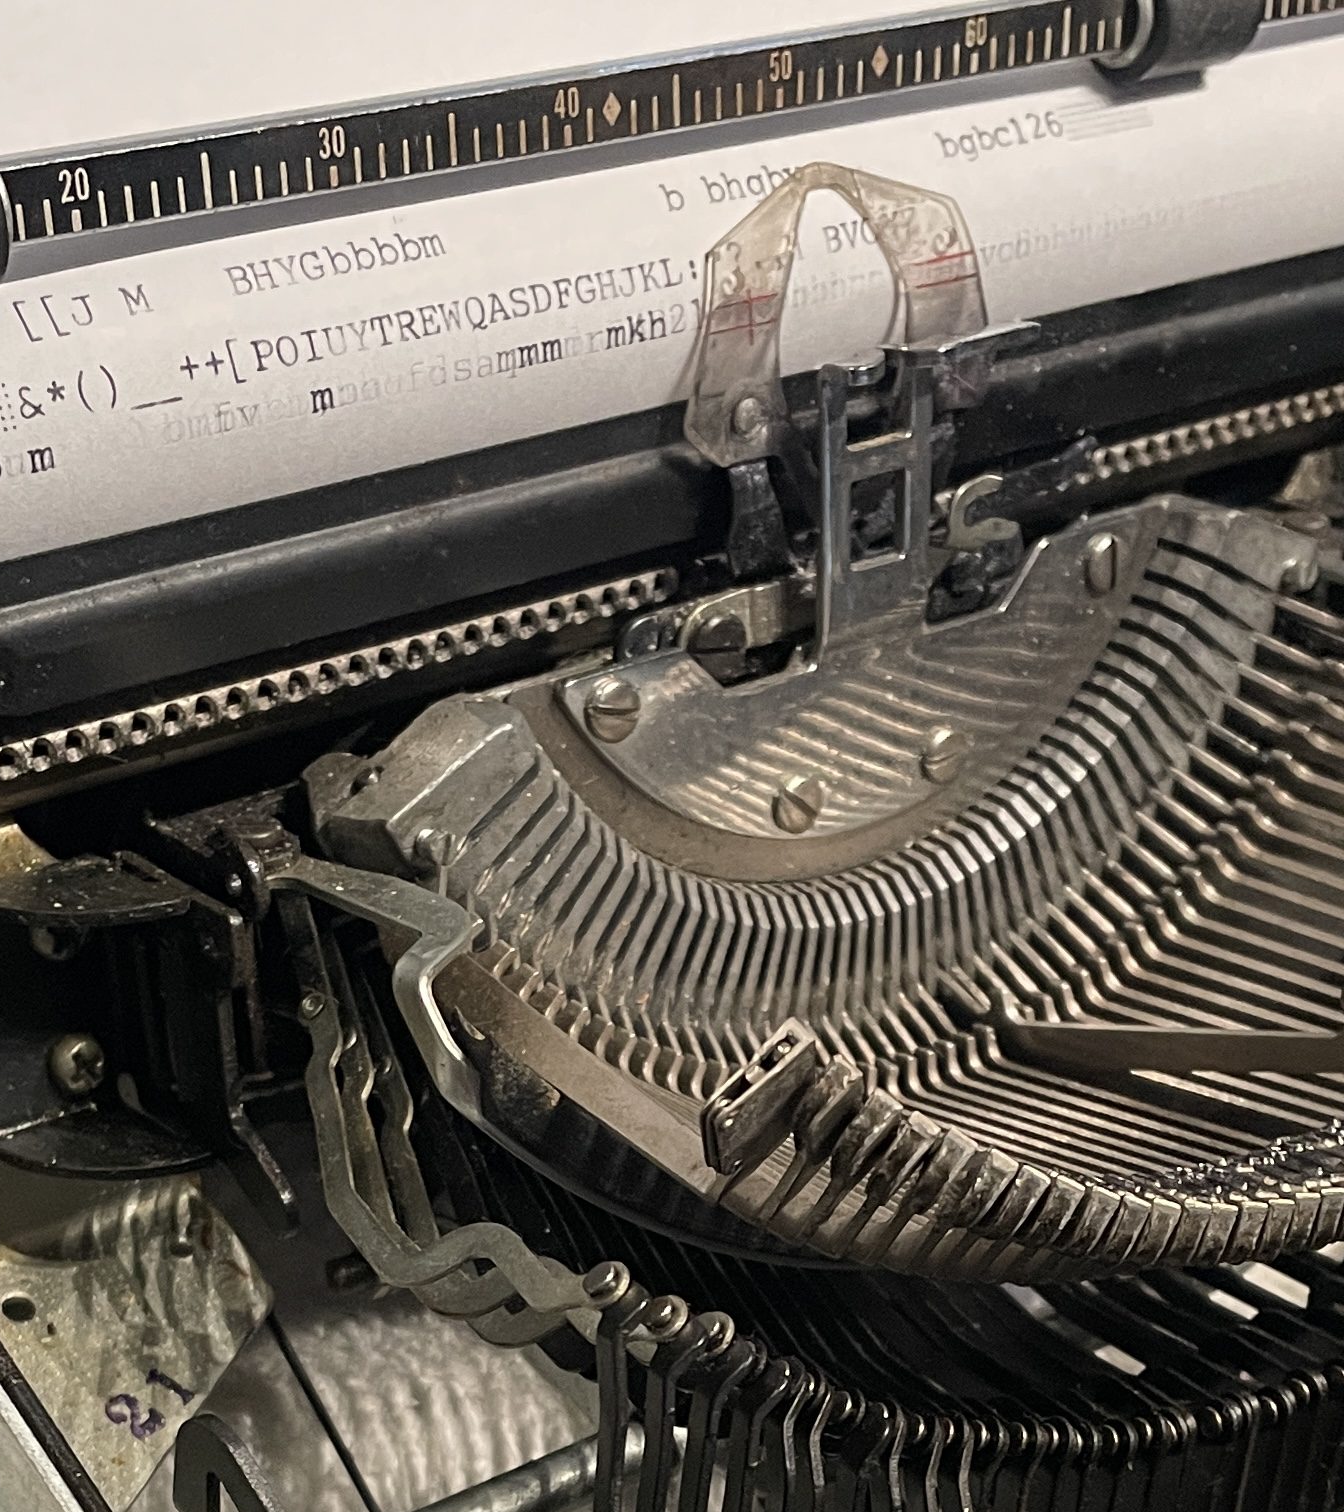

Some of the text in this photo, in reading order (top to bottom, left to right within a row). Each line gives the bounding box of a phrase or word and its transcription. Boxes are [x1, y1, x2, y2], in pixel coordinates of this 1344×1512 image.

[57, 168, 90, 205] 20
[318, 125, 346, 160] 30
[554, 87, 580, 119] 40
[769, 52, 792, 83] 50
[964, 15, 987, 48] 60
[658, 184, 685, 212] b
